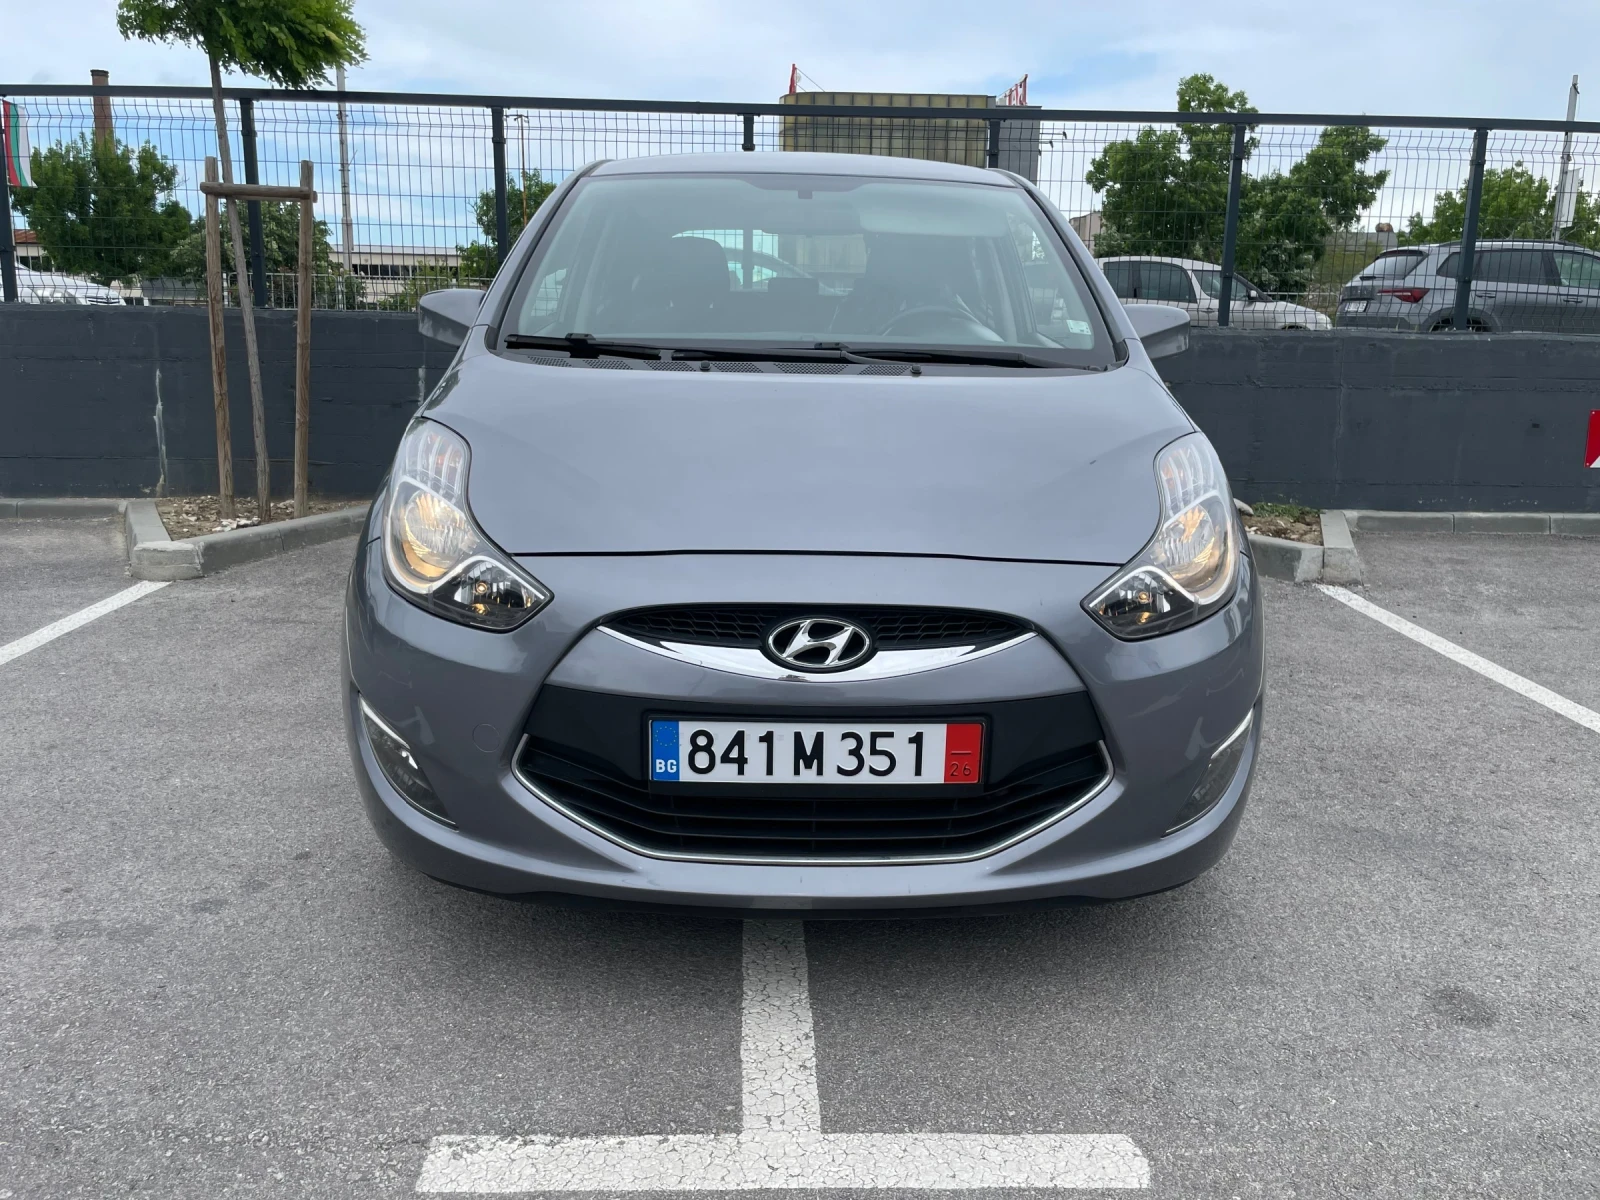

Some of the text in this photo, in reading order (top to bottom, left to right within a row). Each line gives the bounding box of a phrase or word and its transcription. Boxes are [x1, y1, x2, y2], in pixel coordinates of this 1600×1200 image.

[688, 729, 924, 777] 841 M 351
[655, 759, 677, 773] BG
[950, 761, 972, 777] 26
